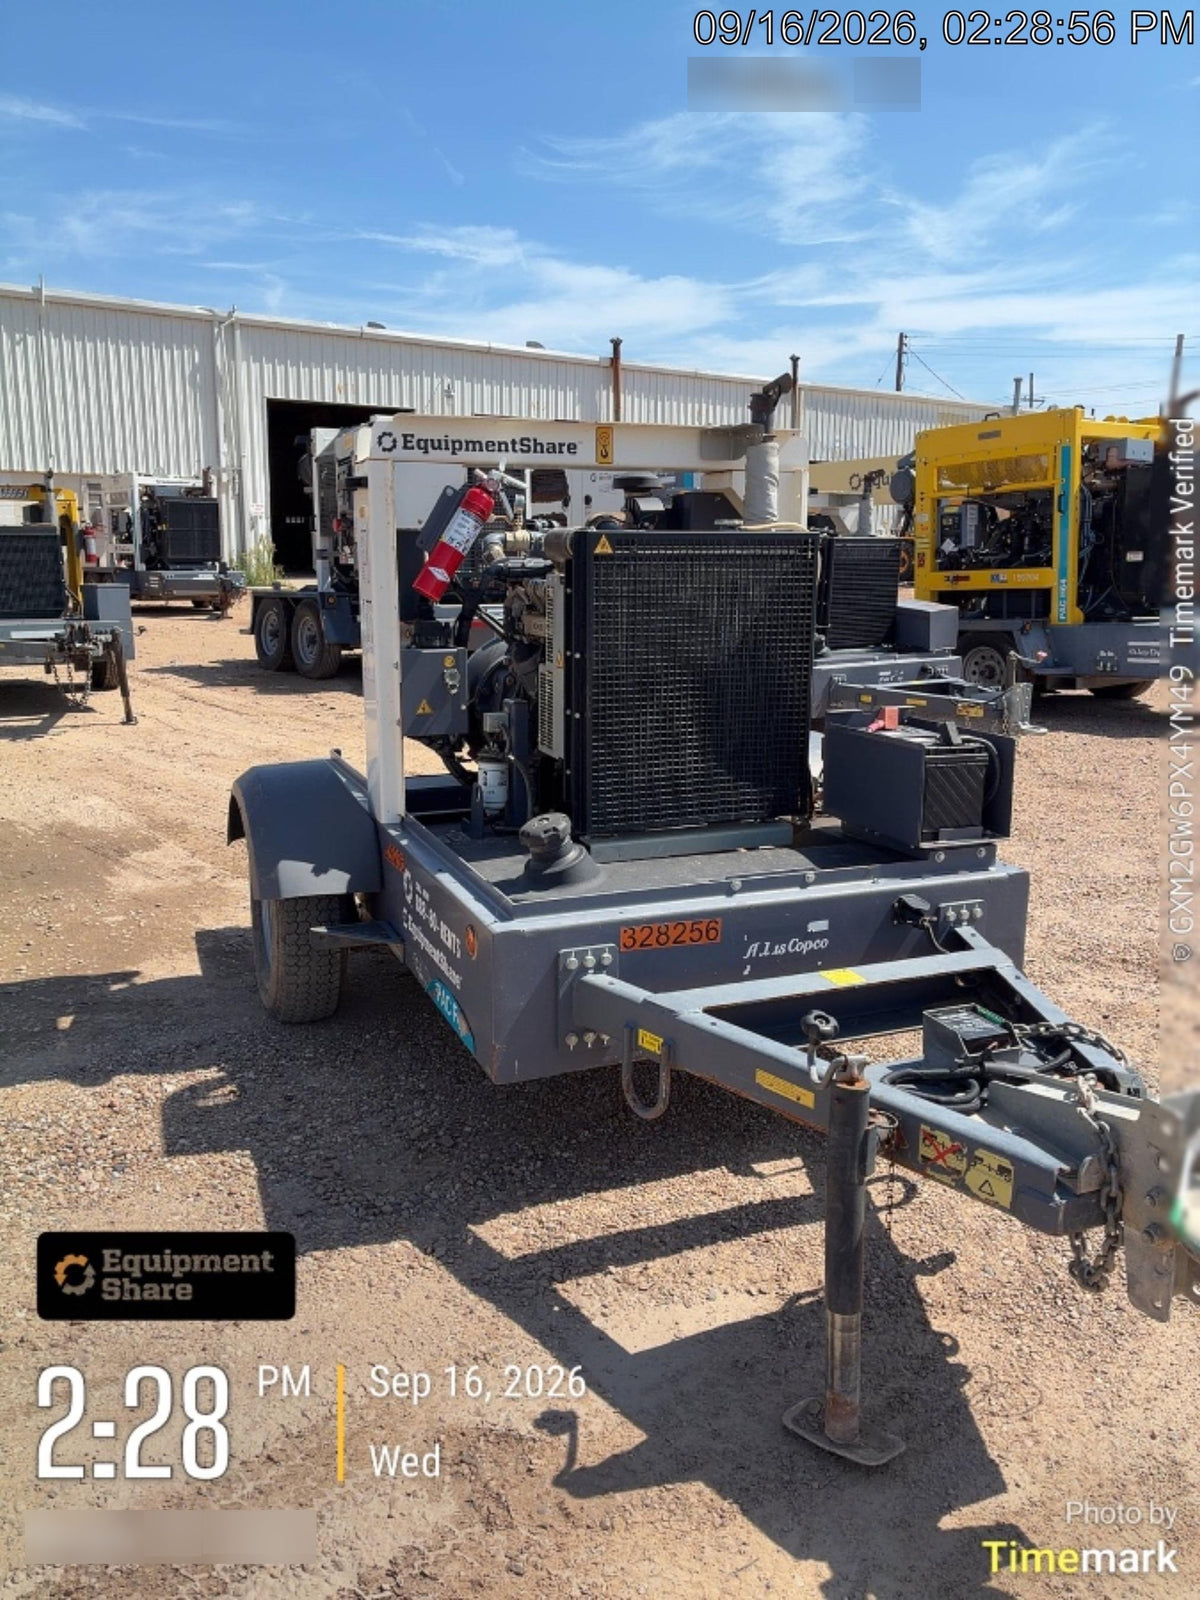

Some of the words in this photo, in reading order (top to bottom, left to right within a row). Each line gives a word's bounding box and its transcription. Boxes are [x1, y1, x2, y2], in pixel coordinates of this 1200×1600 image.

[401, 433, 577, 455] EquipmentShare
[621, 919, 720, 950] 328256
[742, 941, 787, 959] Alas
[787, 938, 829, 955] Copco
